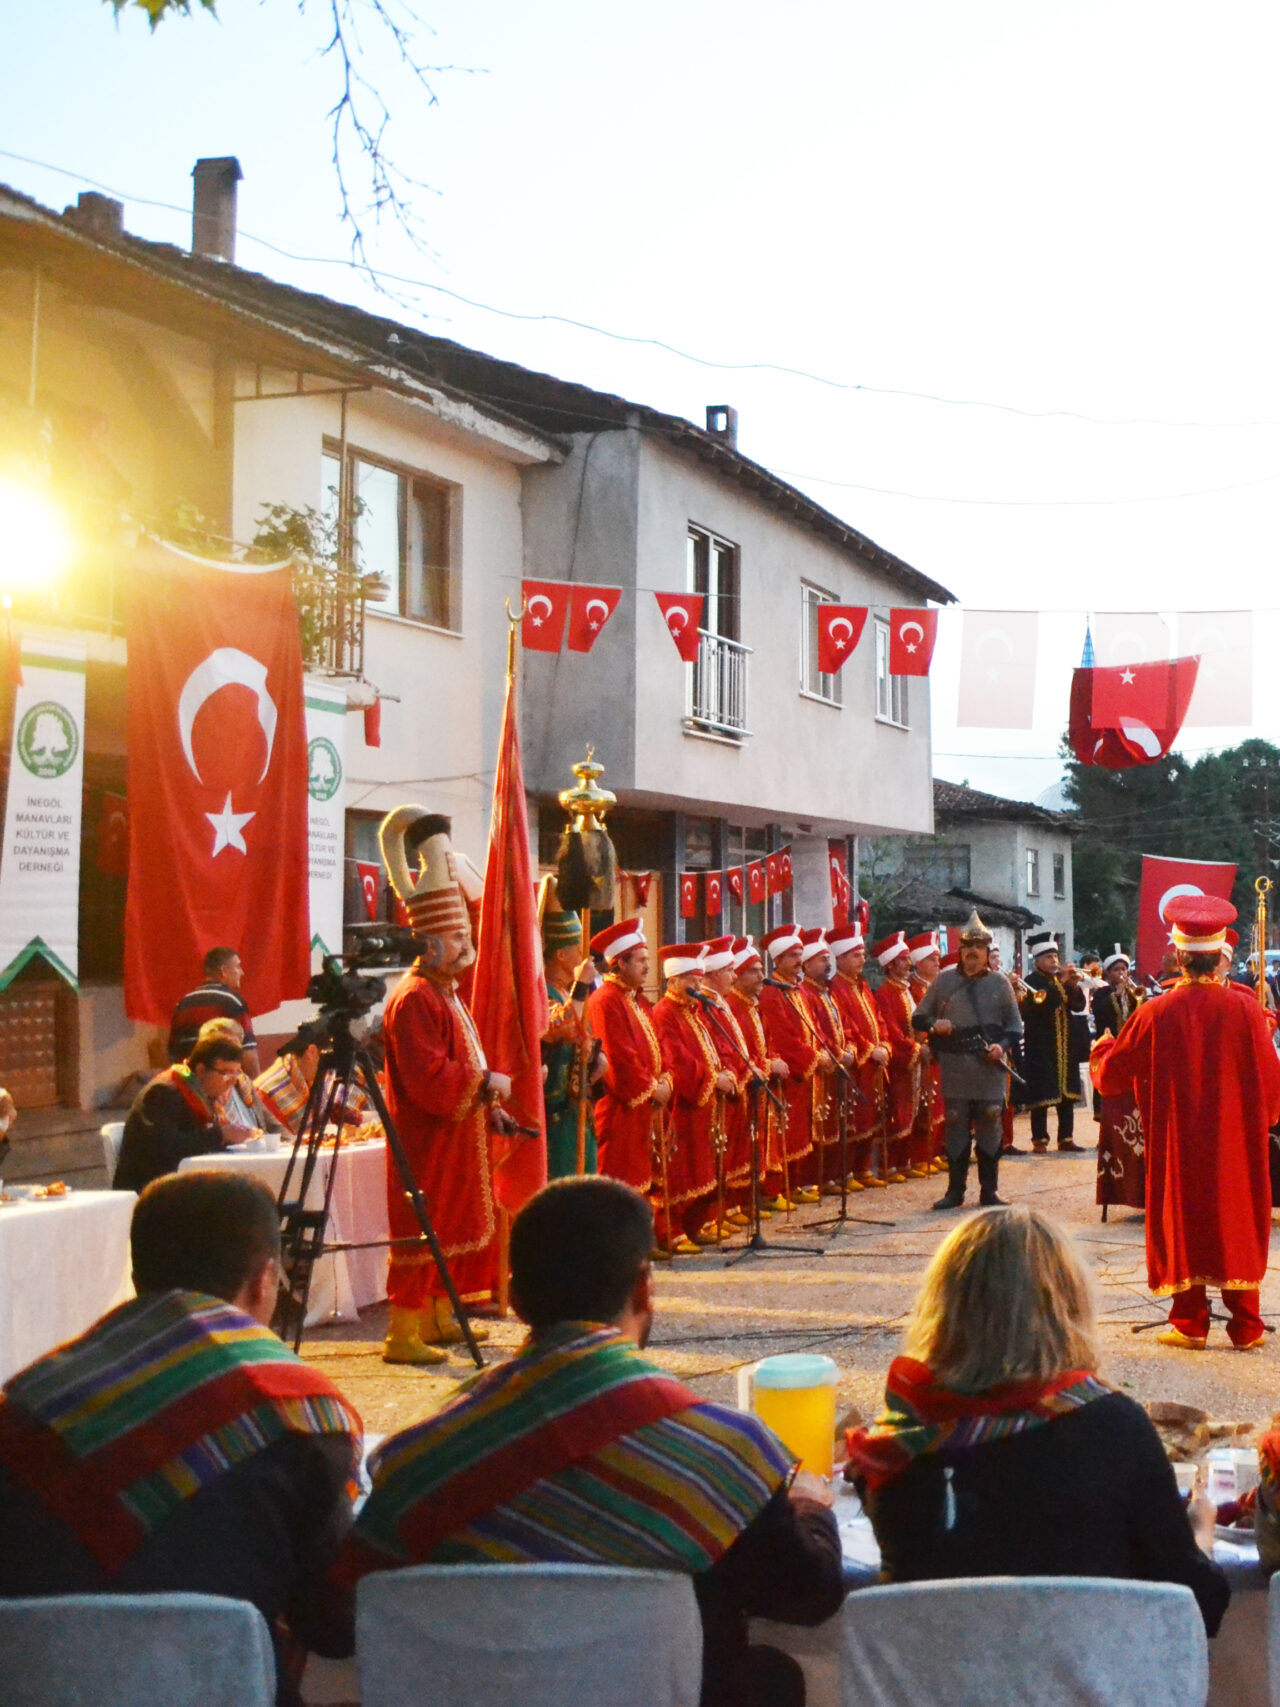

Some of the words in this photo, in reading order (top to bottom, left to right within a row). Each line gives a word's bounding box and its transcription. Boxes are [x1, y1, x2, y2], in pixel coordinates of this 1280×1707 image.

[27, 796, 62, 808] İNEGÖL
[15, 813, 72, 825] MANAVLARI
[16, 829, 54, 840] KÜLTÜR
[57, 831, 70, 841] VE
[13, 846, 70, 858] DAYANIŞMA
[19, 861, 64, 872] DERNEĞİ
